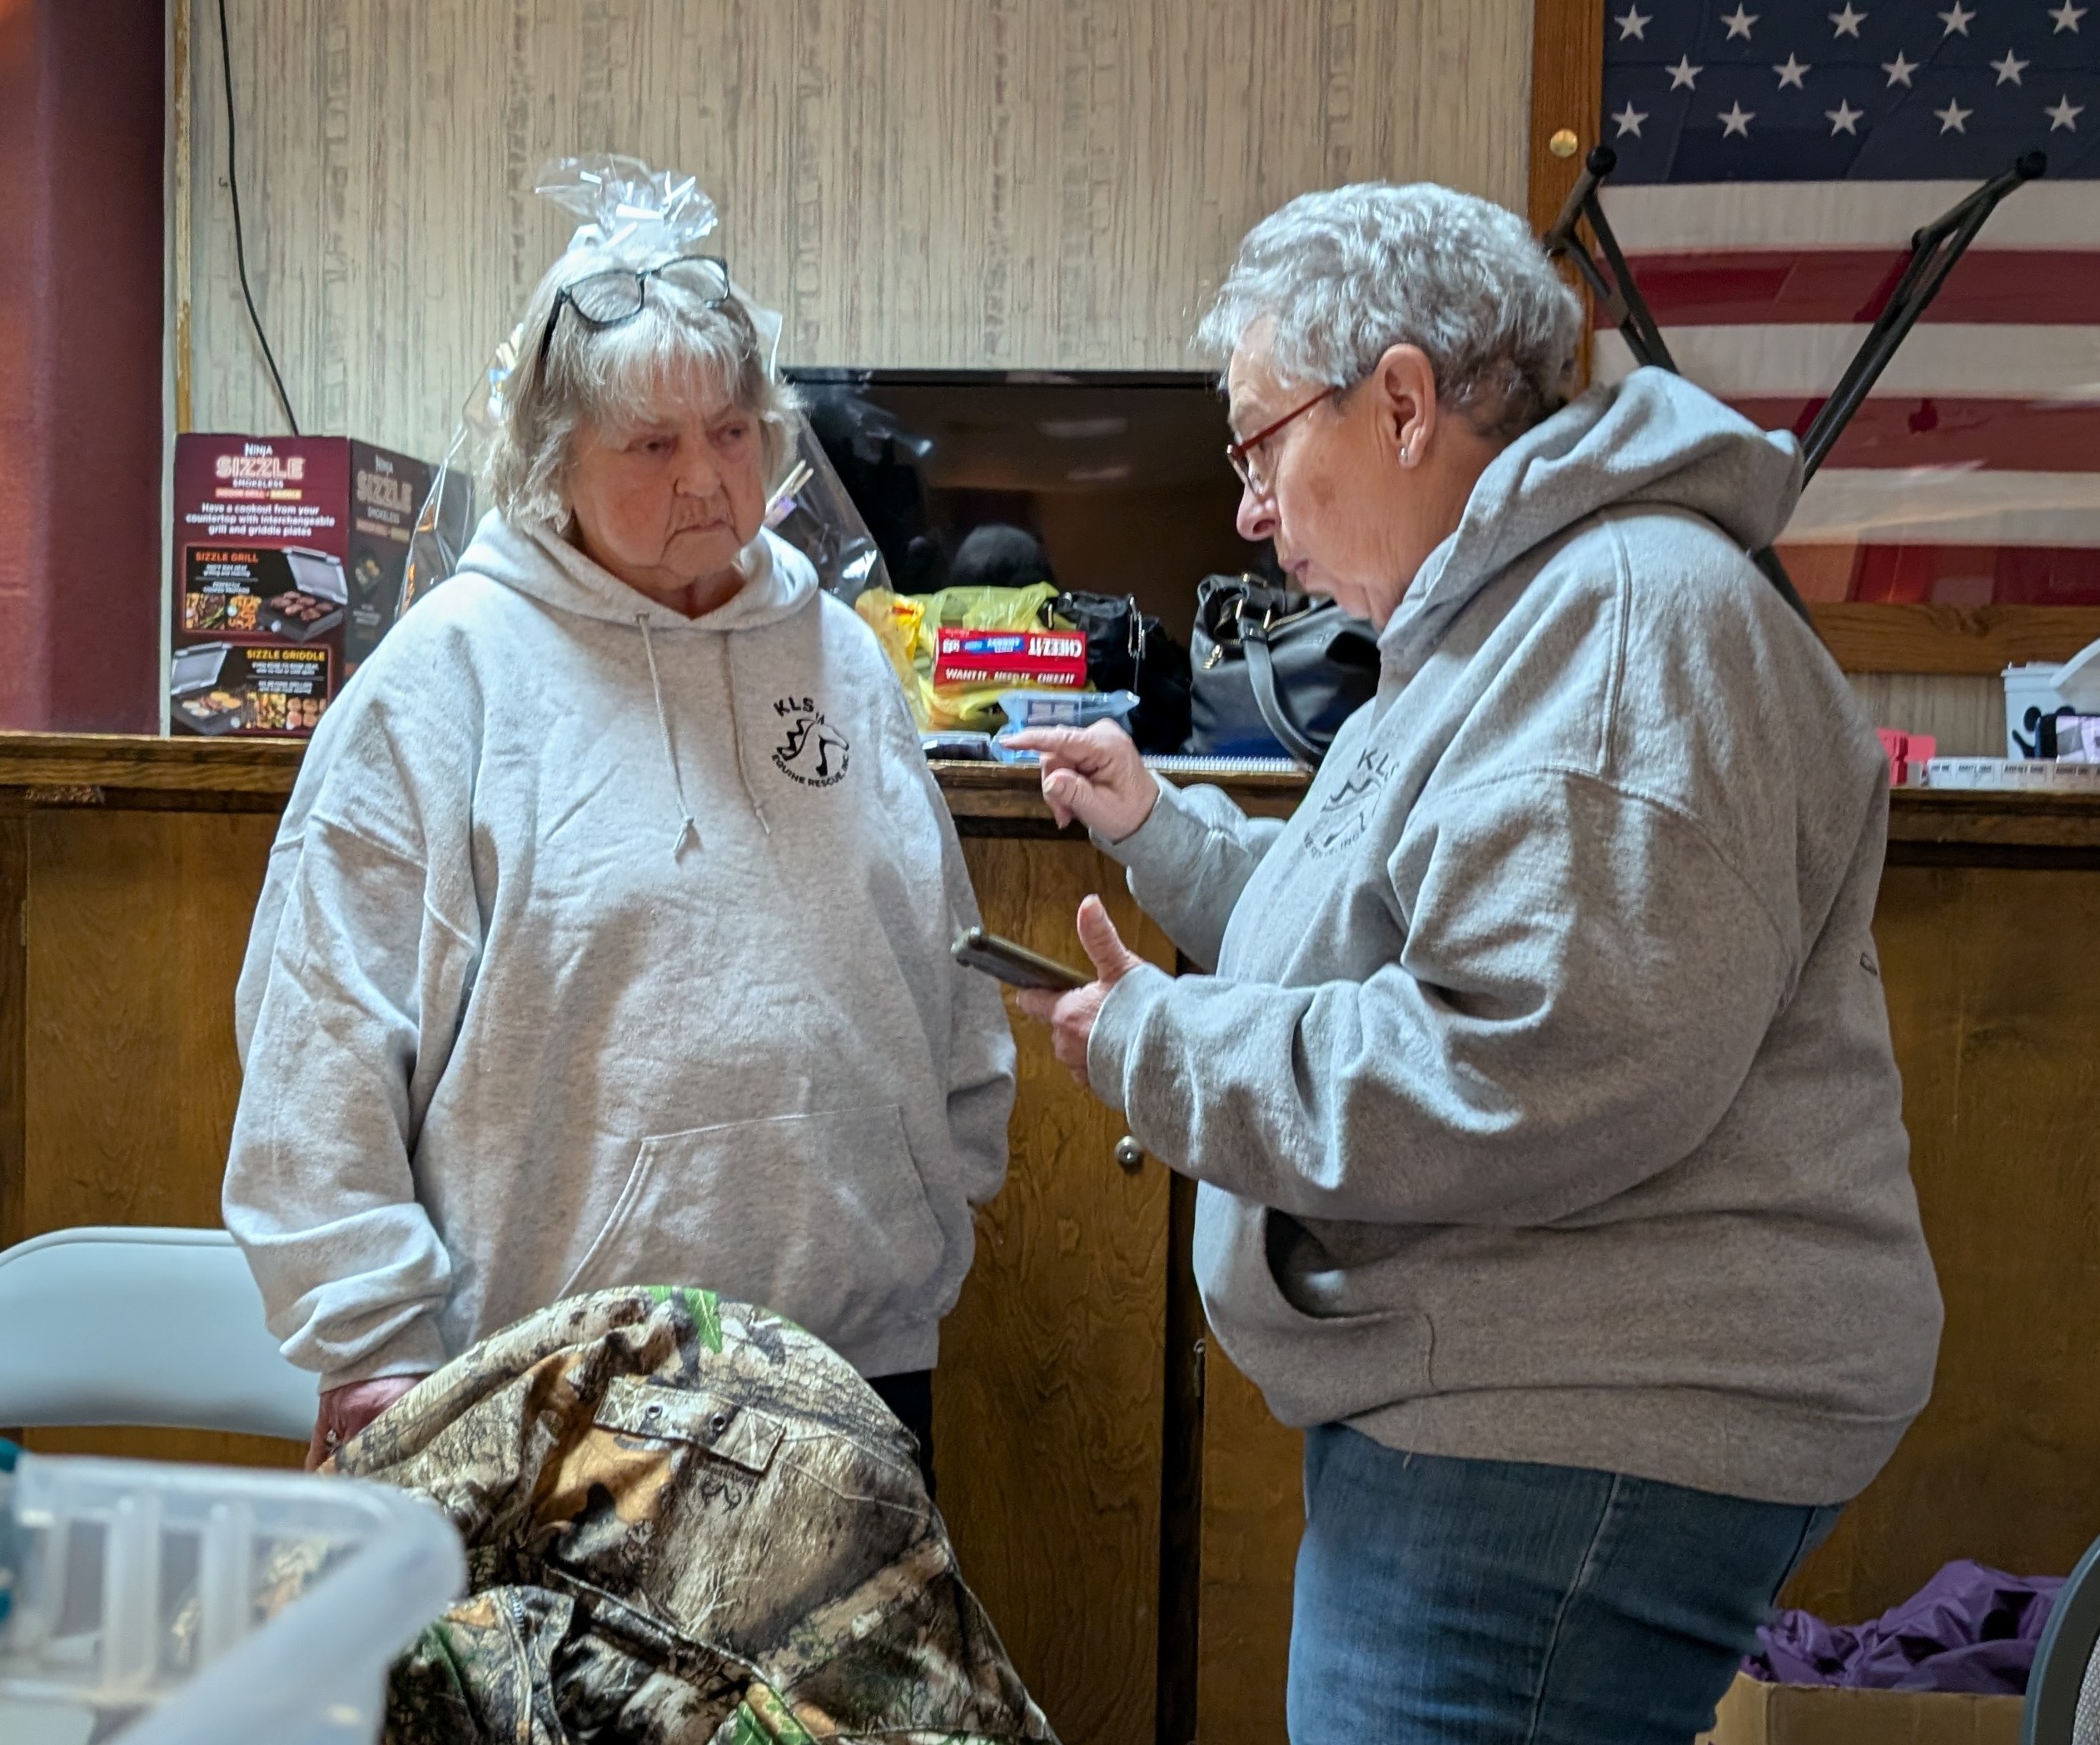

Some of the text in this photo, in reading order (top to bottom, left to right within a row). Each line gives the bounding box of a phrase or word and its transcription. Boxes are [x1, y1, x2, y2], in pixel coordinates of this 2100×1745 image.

[216, 455, 306, 480] SIZZLE
[202, 502, 320, 516] Have a cookout from your
[185, 513, 336, 527] countertop with interchangeable
[208, 524, 312, 538] grill and griddle plates
[196, 552, 259, 564] SIZZLE GRILL
[246, 649, 326, 662] SIZZLE GRIDDLE
[945, 668, 978, 680] WANT
[773, 696, 814, 717] KLS
[771, 753, 806, 784] EQUINE
